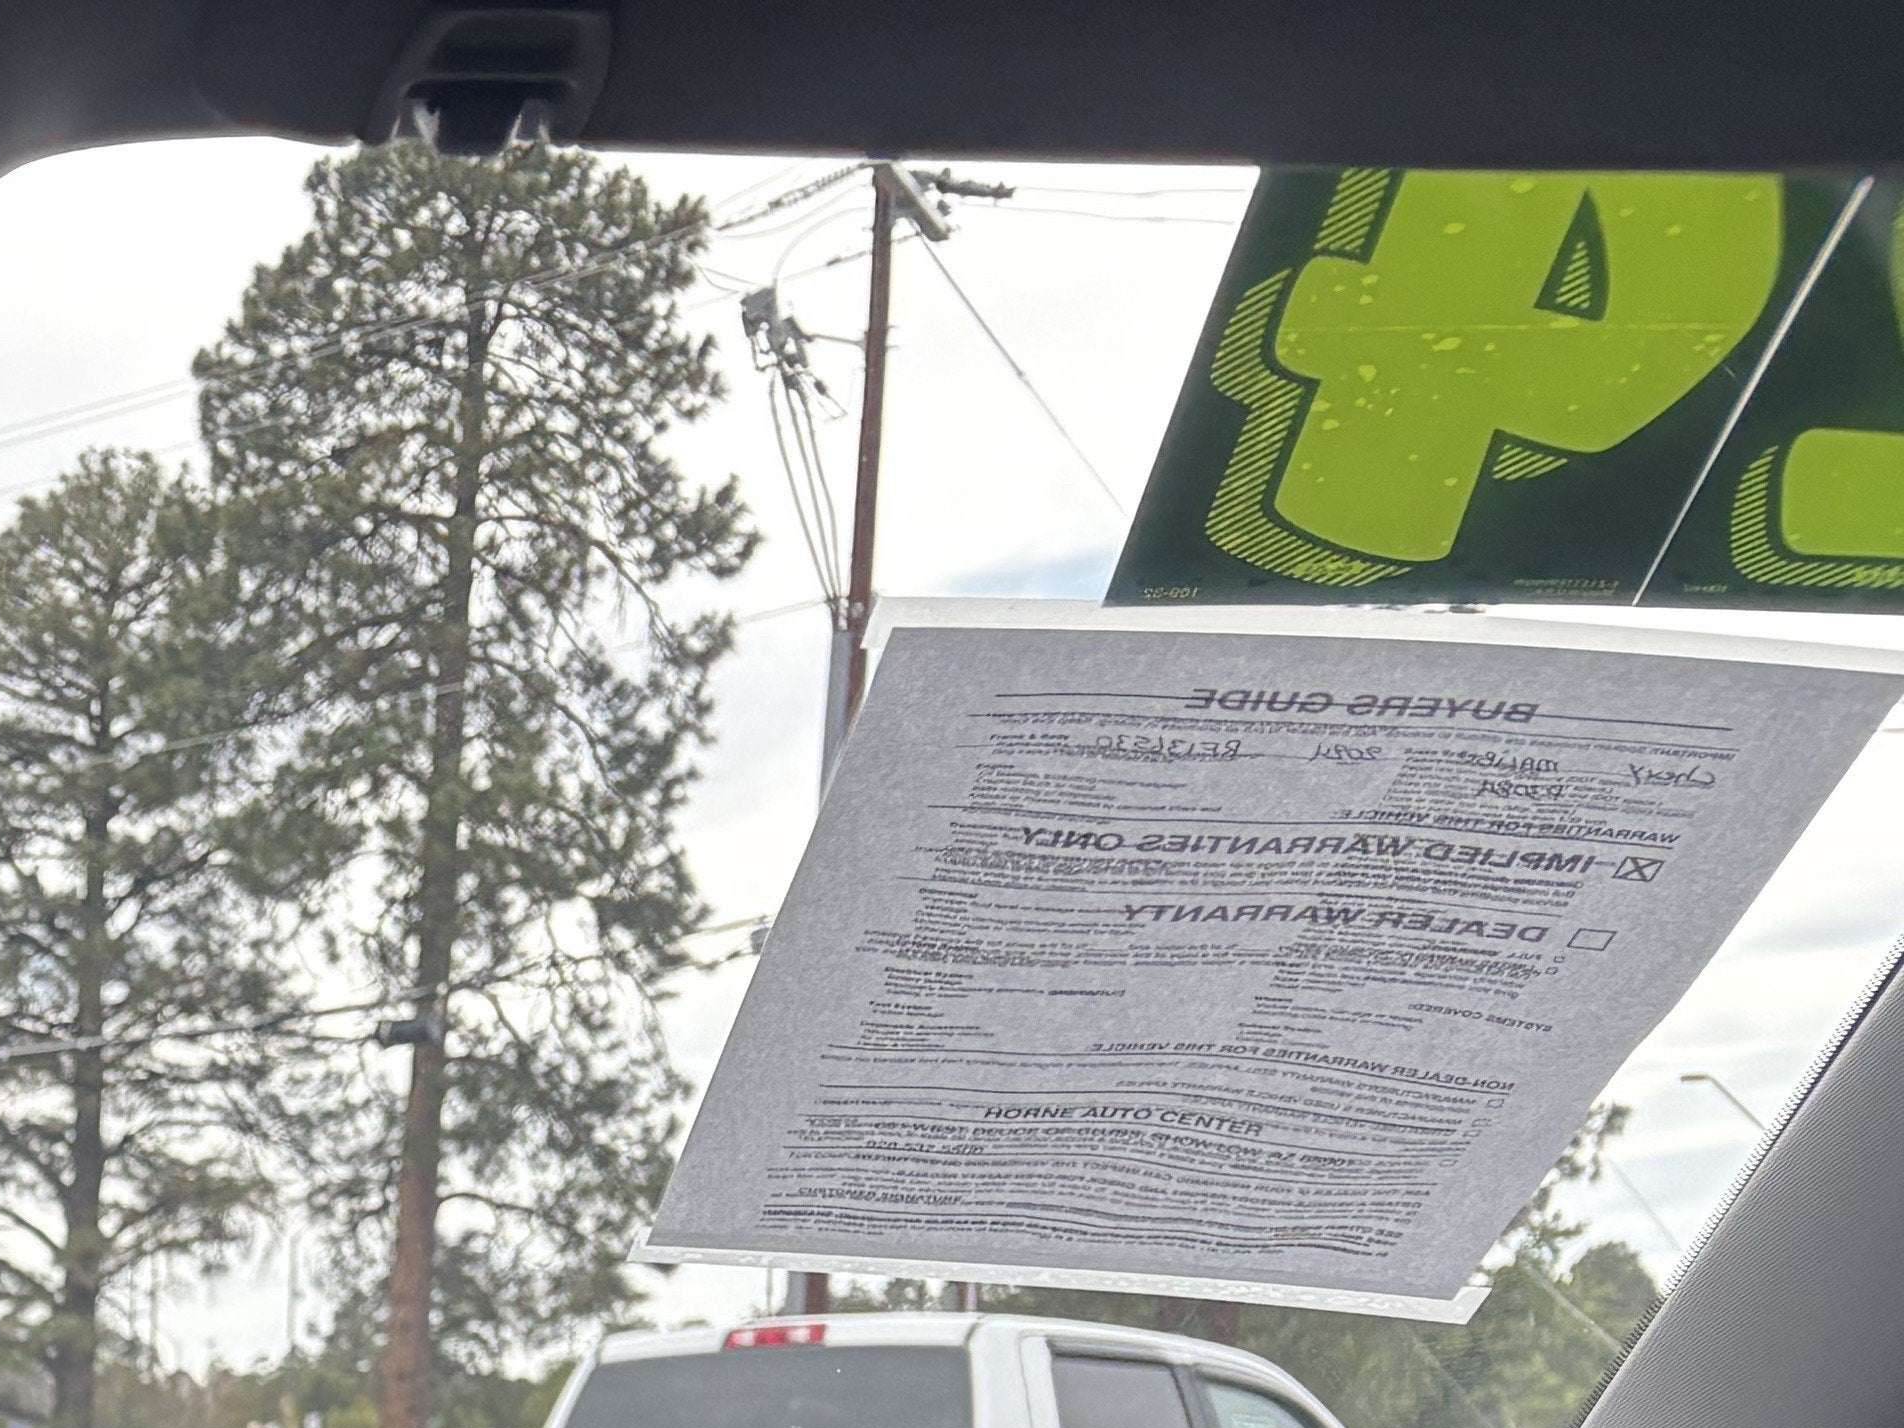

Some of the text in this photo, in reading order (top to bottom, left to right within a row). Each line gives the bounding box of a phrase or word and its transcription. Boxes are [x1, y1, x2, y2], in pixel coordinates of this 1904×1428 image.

[984, 1106, 1264, 1137] HORNE AUTO CENTER
